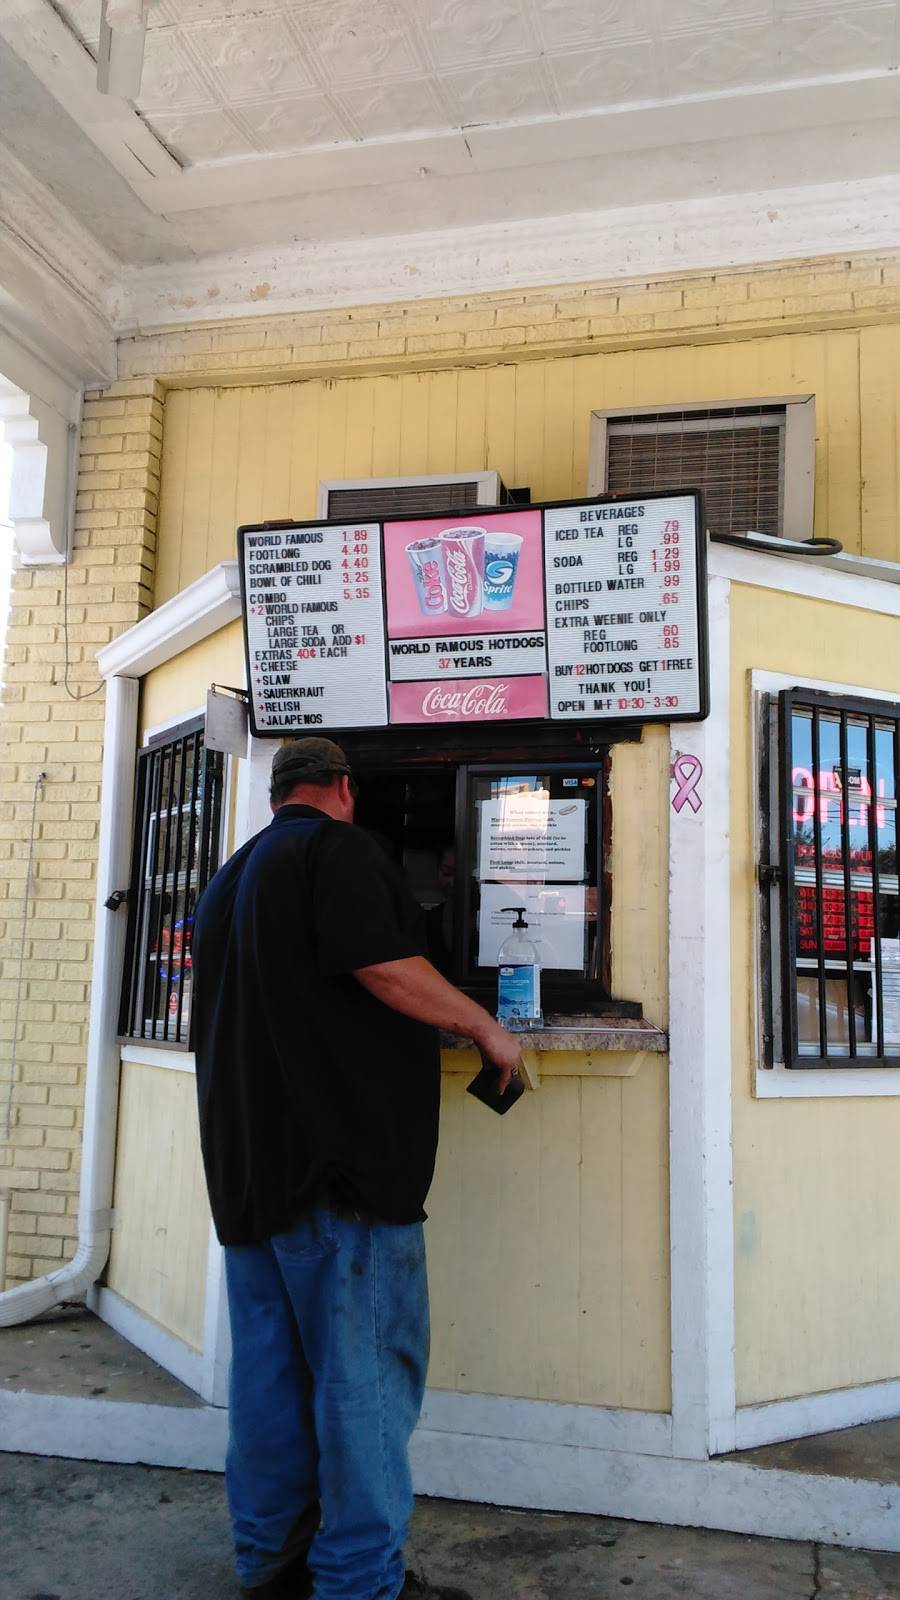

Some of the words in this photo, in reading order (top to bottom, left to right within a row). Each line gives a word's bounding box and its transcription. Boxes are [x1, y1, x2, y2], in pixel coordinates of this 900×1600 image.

[580, 506, 645, 522] BEVERAGES
[248, 536, 281, 547] WORLD
[286, 533, 323, 543] FAMOUS
[342, 530, 368, 542] 1.89
[555, 530, 578, 541] ICED
[584, 527, 604, 539] TEA
[618, 524, 638, 535] REG
[660, 533, 679, 545] .99
[250, 548, 300, 560] FOOTLONG
[341, 544, 368, 555] 4.40
[554, 556, 583, 567] SODA
[618, 552, 638, 563] REG
[652, 548, 679, 560] 1.29
[249, 562, 309, 574] SCRAMBLED
[312, 560, 331, 571] DOG
[341, 558, 368, 569] 4.40
[652, 560, 680, 573] 1.99
[250, 577, 278, 588] BOWL
[280, 576, 291, 586] OF
[296, 574, 321, 585] CHILI
[342, 572, 368, 584] 3.25
[555, 581, 602, 594] BOTTLED
[607, 578, 644, 591] WATER
[659, 575, 679, 588] .99
[250, 592, 286, 604] COMBO
[343, 588, 370, 600] 5.35
[483, 581, 513, 596] Sprite
[266, 603, 298, 614] WORLD
[301, 602, 338, 613] FAMOUS
[556, 599, 590, 611] CHIPS
[659, 593, 678, 606] .65
[266, 615, 294, 626] CHIPS
[555, 617, 589, 628] EXTRA
[594, 613, 633, 626] WEENIE
[640, 610, 667, 622] ONLY
[268, 627, 297, 637] LARGE
[301, 626, 318, 636] TEA
[332, 624, 344, 635] OR
[584, 630, 606, 640] REG
[269, 637, 300, 649] LARGE
[302, 636, 326, 647] SODA
[332, 635, 352, 646] ADD
[355, 635, 366, 645] $1
[391, 643, 430, 655] WORLD
[436, 640, 484, 653] FAMOUS
[489, 637, 544, 650] HOTDOGS
[584, 640, 638, 653] FOOTLONG
[255, 650, 292, 661] EXTRAS
[297, 648, 316, 659] 40¢
[320, 647, 347, 657] EACH
[439, 658, 450, 669] 37
[453, 656, 492, 668] YEARS
[555, 664, 573, 676] BUY
[575, 664, 585, 676] 12
[640, 660, 658, 672] GET
[661, 660, 667, 671] 1
[667, 658, 693, 670] FREE
[579, 682, 616, 694] THANK
[624, 678, 651, 693] YOU!
[558, 700, 585, 712] OPEN
